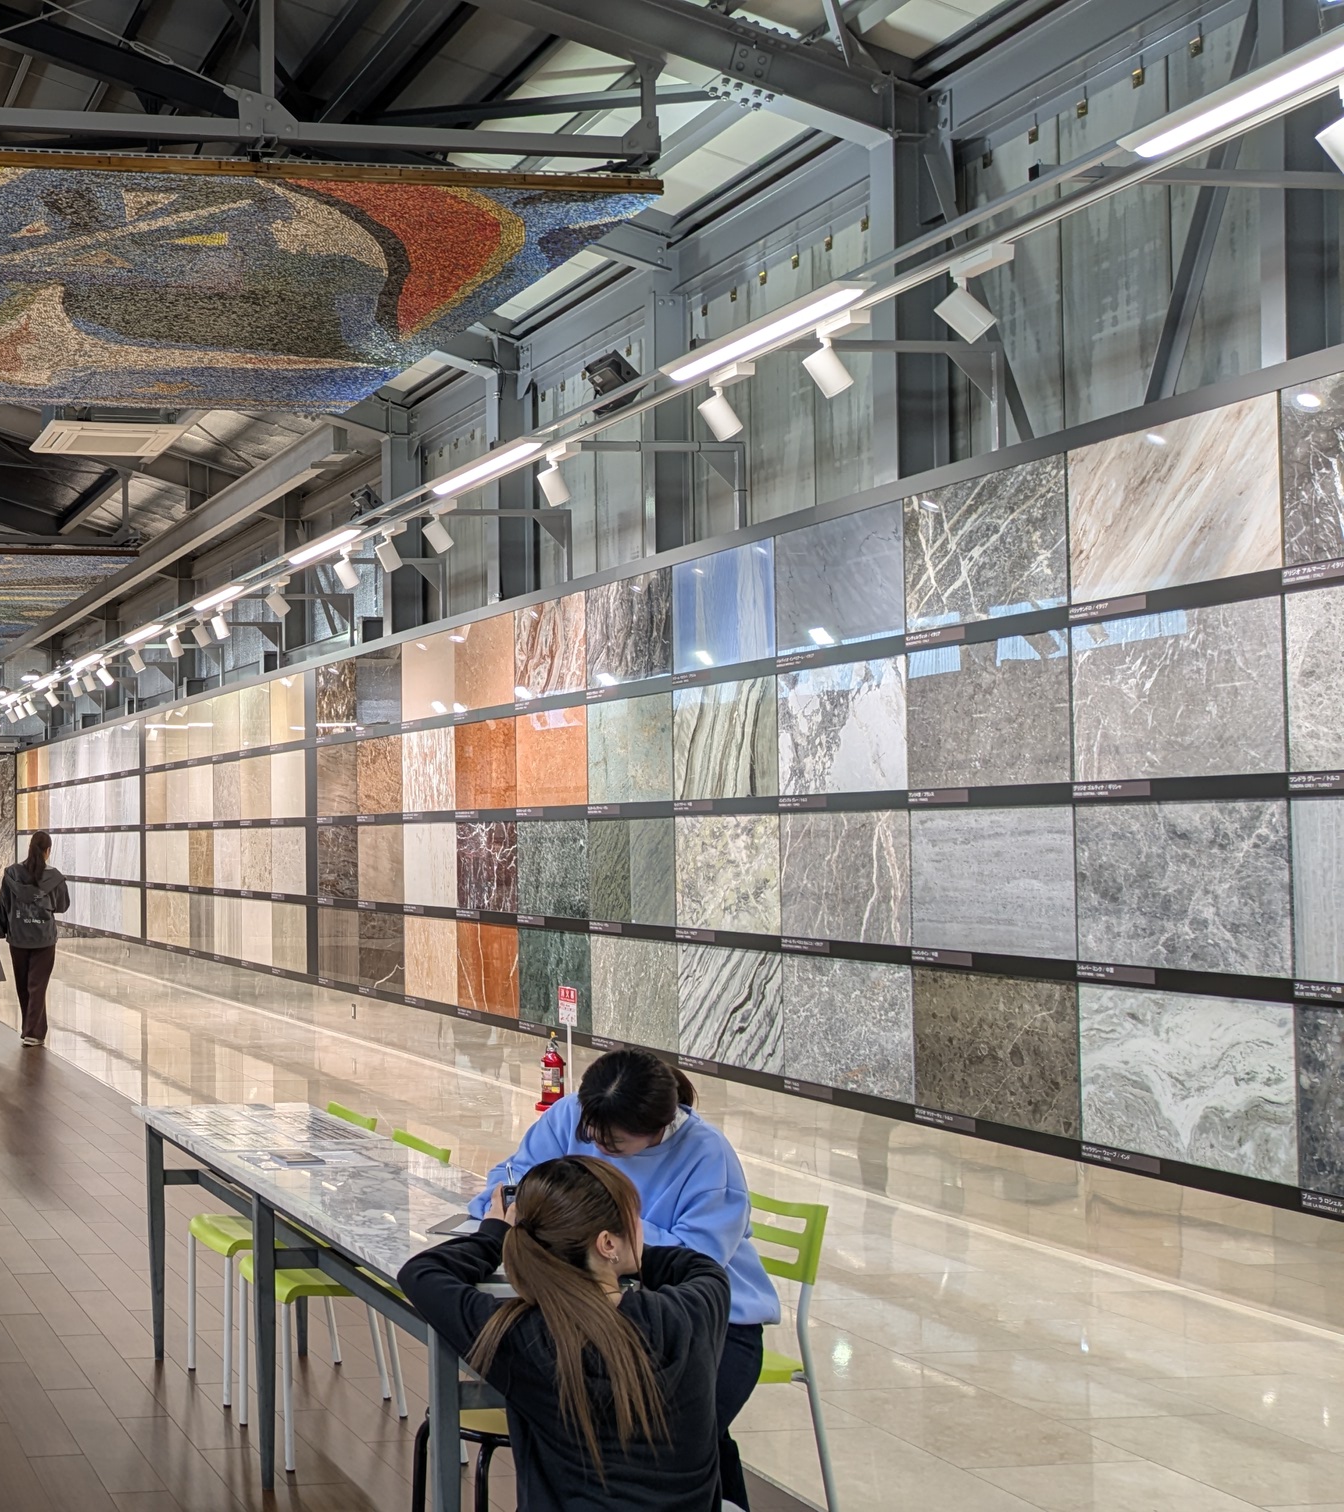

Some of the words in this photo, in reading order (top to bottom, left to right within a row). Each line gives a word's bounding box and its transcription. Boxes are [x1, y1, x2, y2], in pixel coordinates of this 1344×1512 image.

[1283, 569, 1301, 578] グリジオ
[1302, 565, 1326, 574] アルマーニ
[1324, 1198, 1343, 1207] ロシェル
